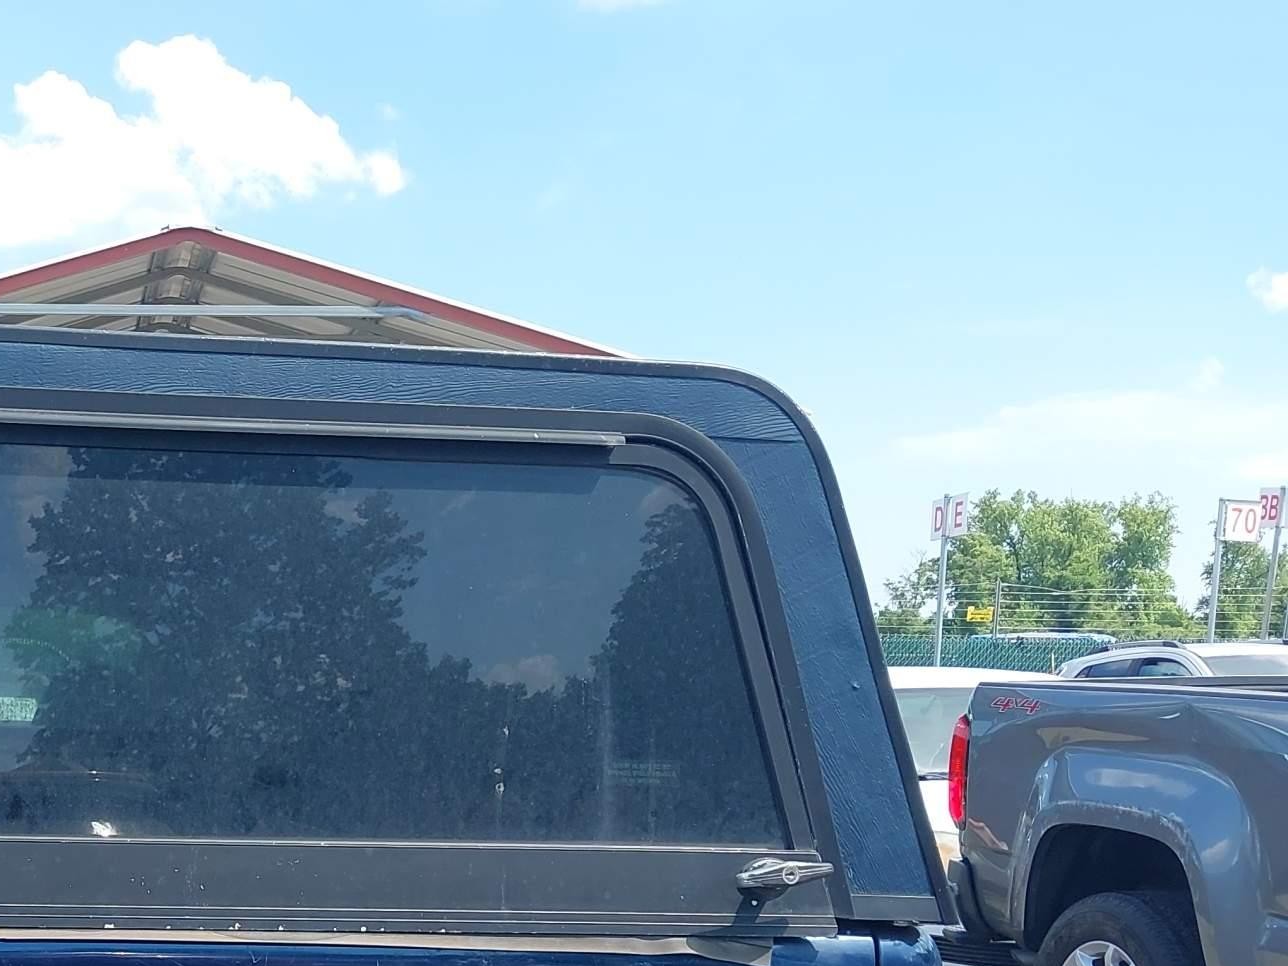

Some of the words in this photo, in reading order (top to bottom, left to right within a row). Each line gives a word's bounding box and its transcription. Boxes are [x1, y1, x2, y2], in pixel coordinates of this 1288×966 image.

[934, 506, 944, 532] D
[954, 501, 964, 528] E
[1231, 507, 1257, 534] 70
